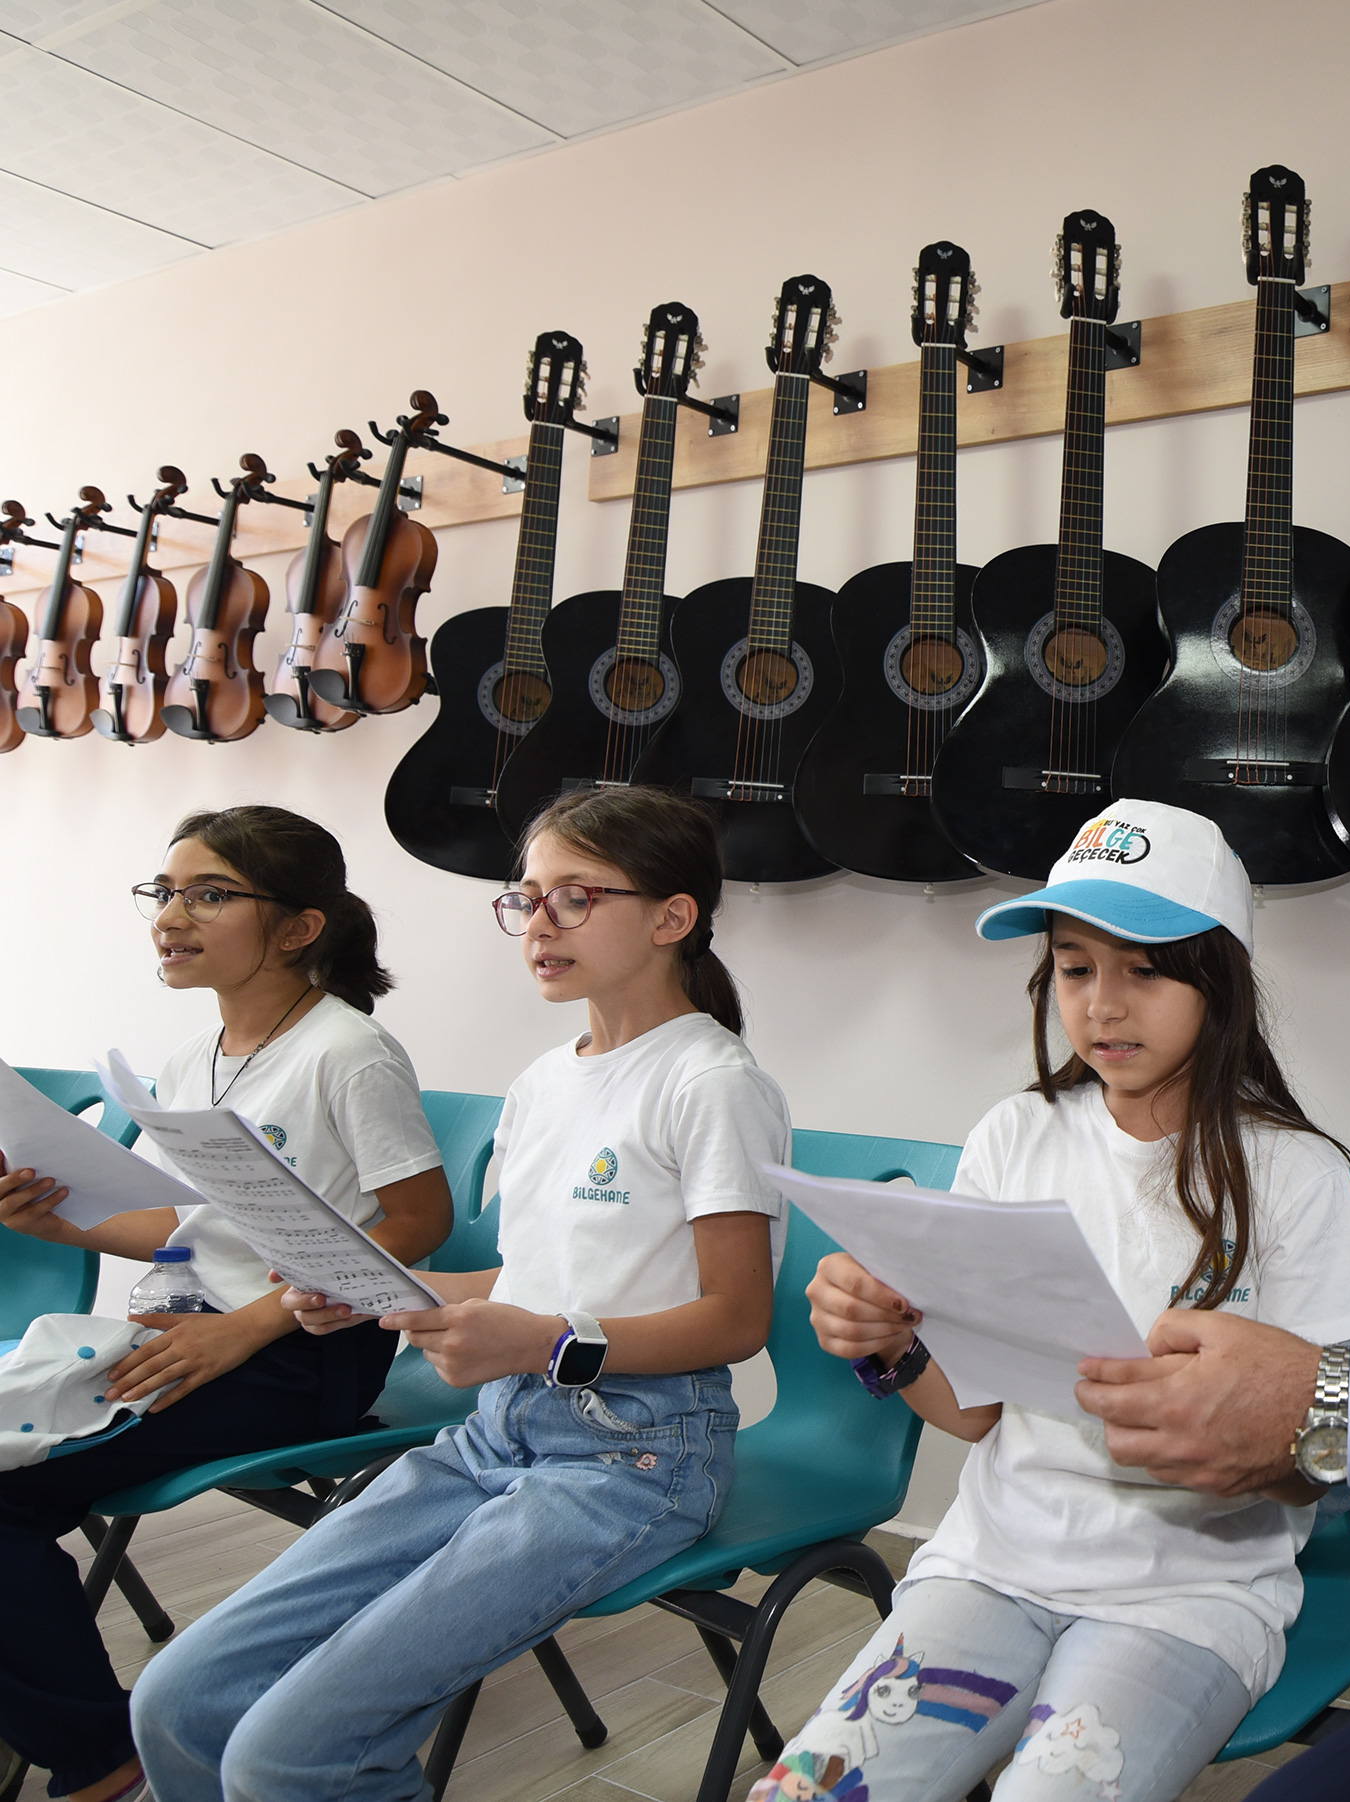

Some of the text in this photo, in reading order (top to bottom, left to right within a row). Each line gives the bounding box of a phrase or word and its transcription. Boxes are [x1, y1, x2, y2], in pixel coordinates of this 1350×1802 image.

[1115, 821, 1130, 829] YAZ
[1131, 826, 1147, 834] ÇOK
[1068, 848, 1130, 864] GEÇECEK
